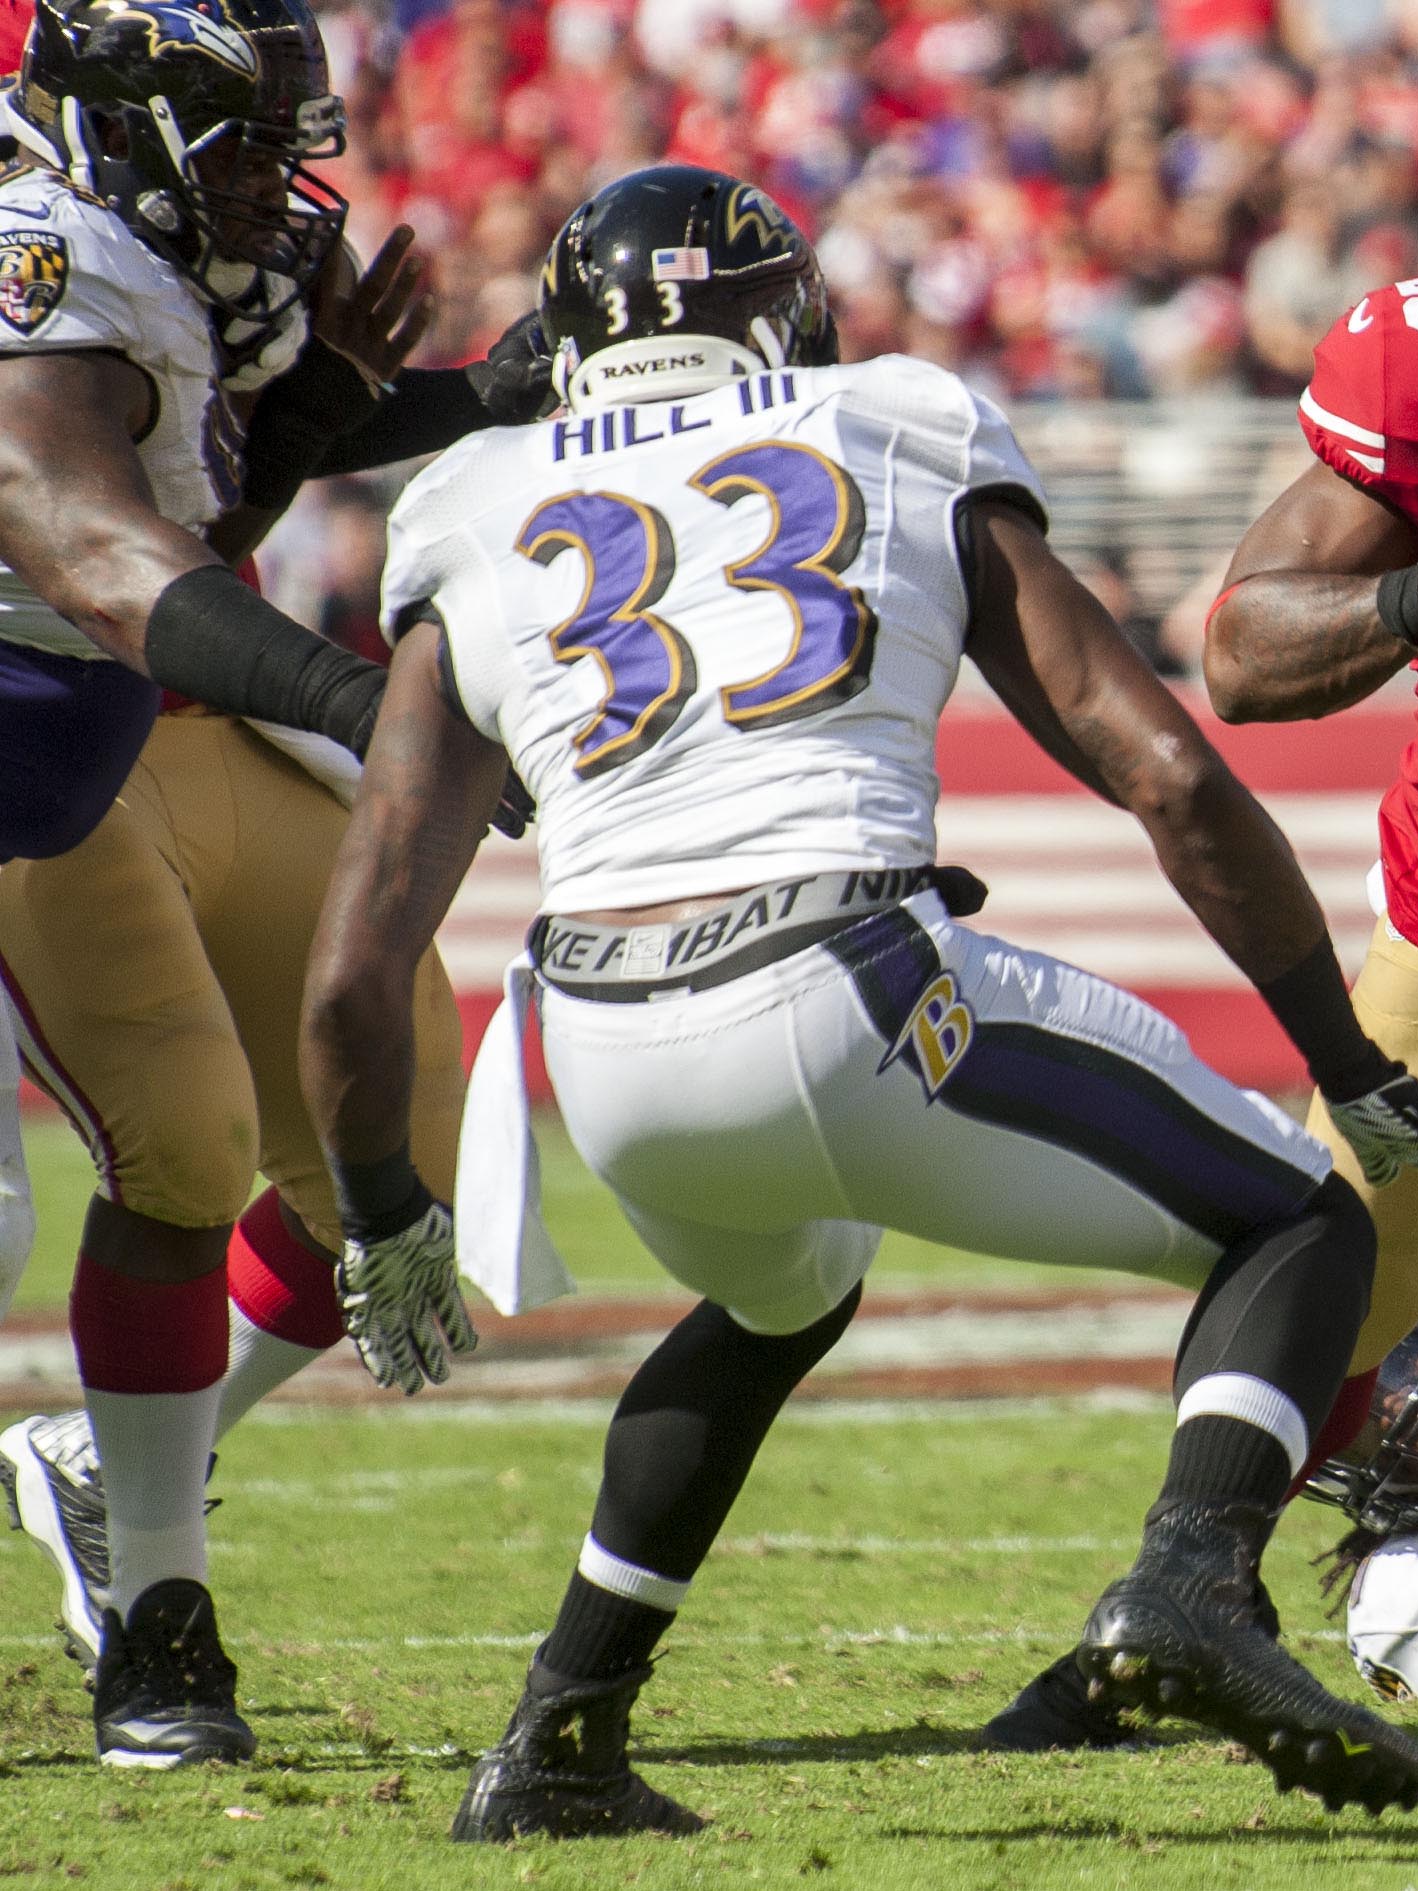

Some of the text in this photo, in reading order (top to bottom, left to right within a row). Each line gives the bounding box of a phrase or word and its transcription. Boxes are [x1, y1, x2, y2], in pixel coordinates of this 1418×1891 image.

[600, 353, 705, 379] RAVENS
[552, 374, 797, 462] HILL III
[513, 439, 878, 780] 33
